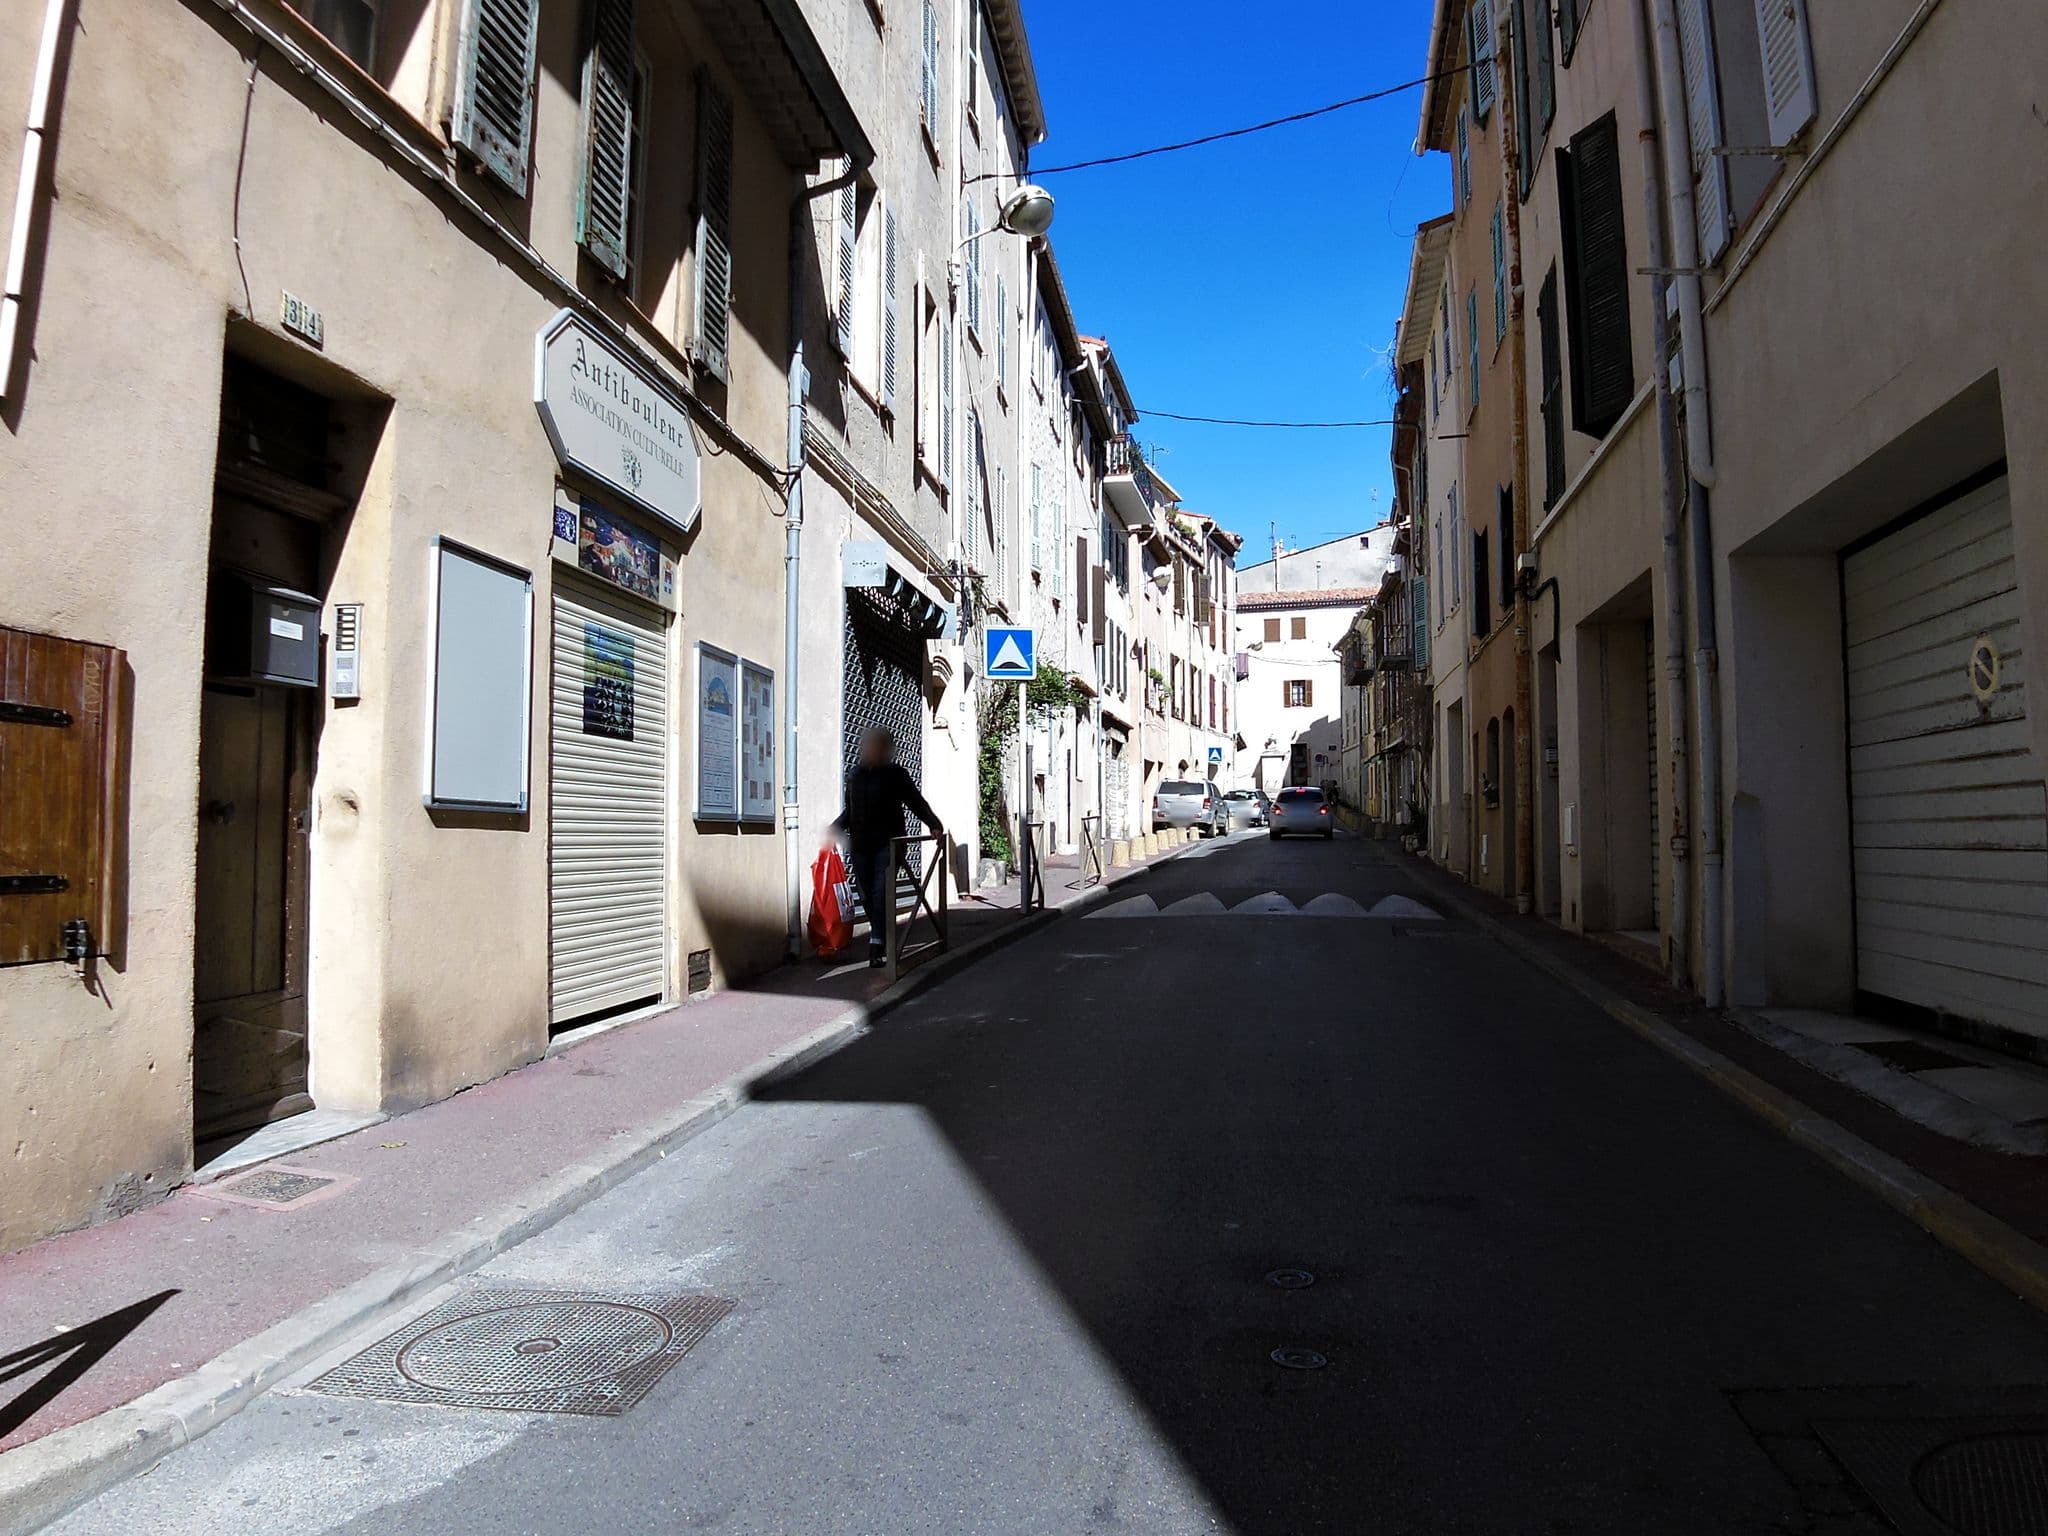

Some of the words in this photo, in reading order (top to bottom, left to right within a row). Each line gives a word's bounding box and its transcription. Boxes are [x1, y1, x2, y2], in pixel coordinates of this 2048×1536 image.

[289, 300, 316, 335] 34
[570, 385, 632, 439] ASSOCIATION
[632, 428, 684, 479] CULTURELLE
